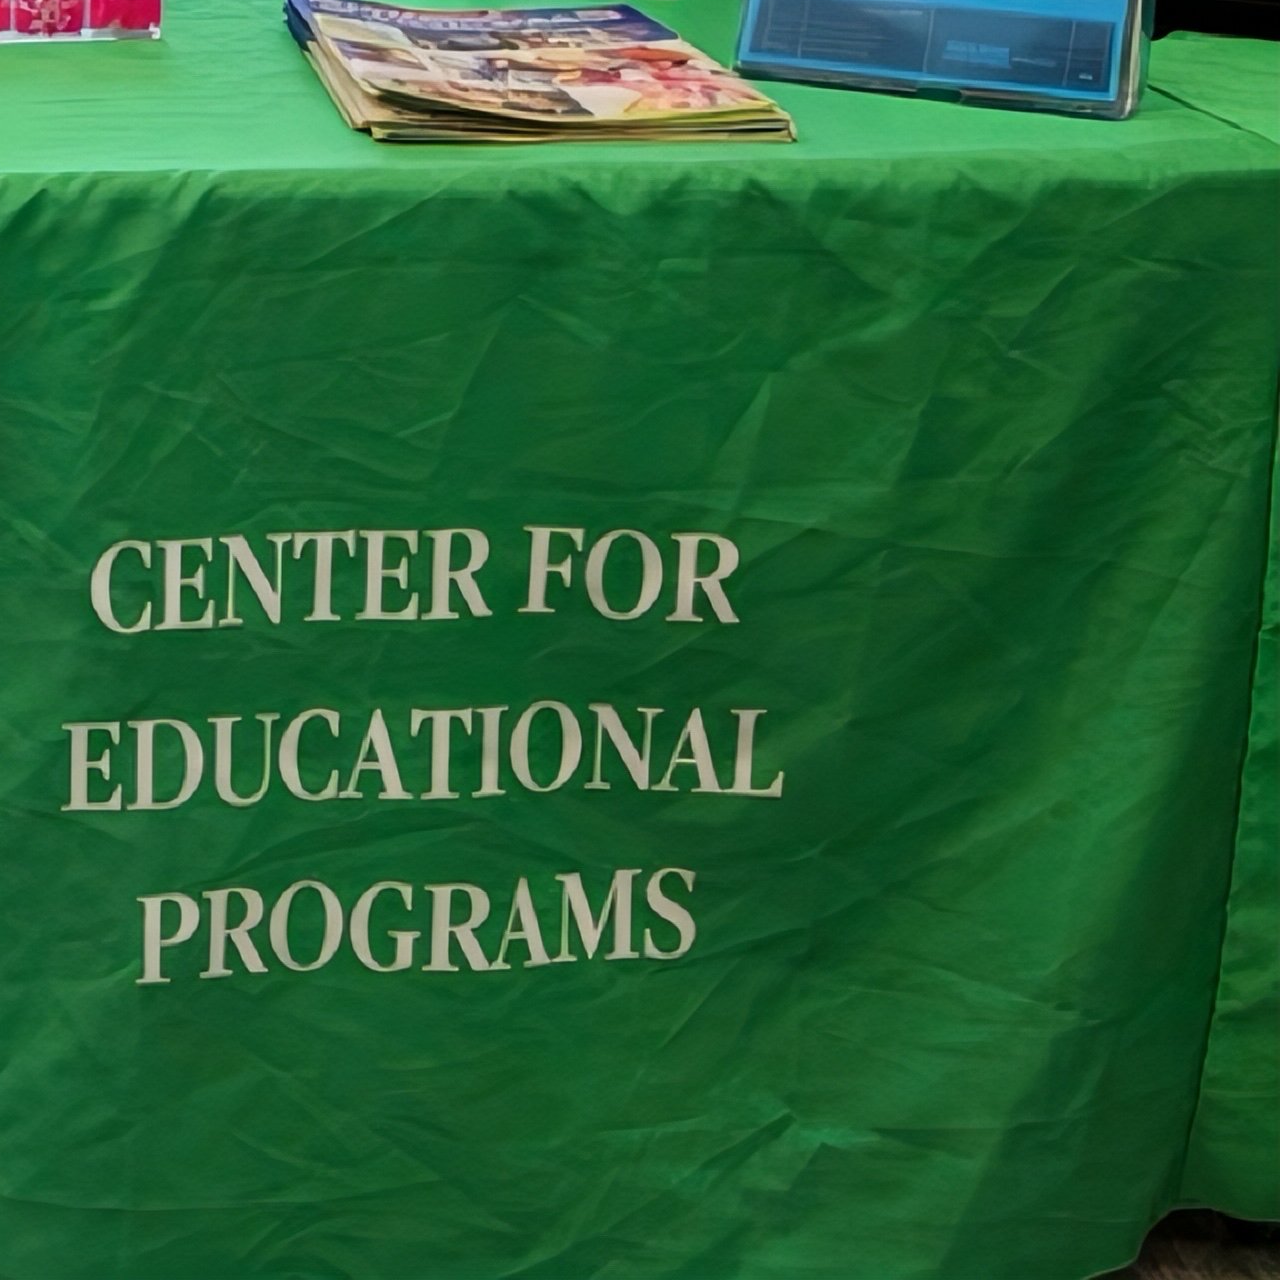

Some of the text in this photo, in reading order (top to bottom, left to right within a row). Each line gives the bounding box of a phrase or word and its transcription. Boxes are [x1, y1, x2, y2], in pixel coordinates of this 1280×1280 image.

[89, 526, 740, 634] CENTER FOR
[60, 700, 785, 812] EDUCATIONAL
[135, 867, 698, 985] PROGRAMS
